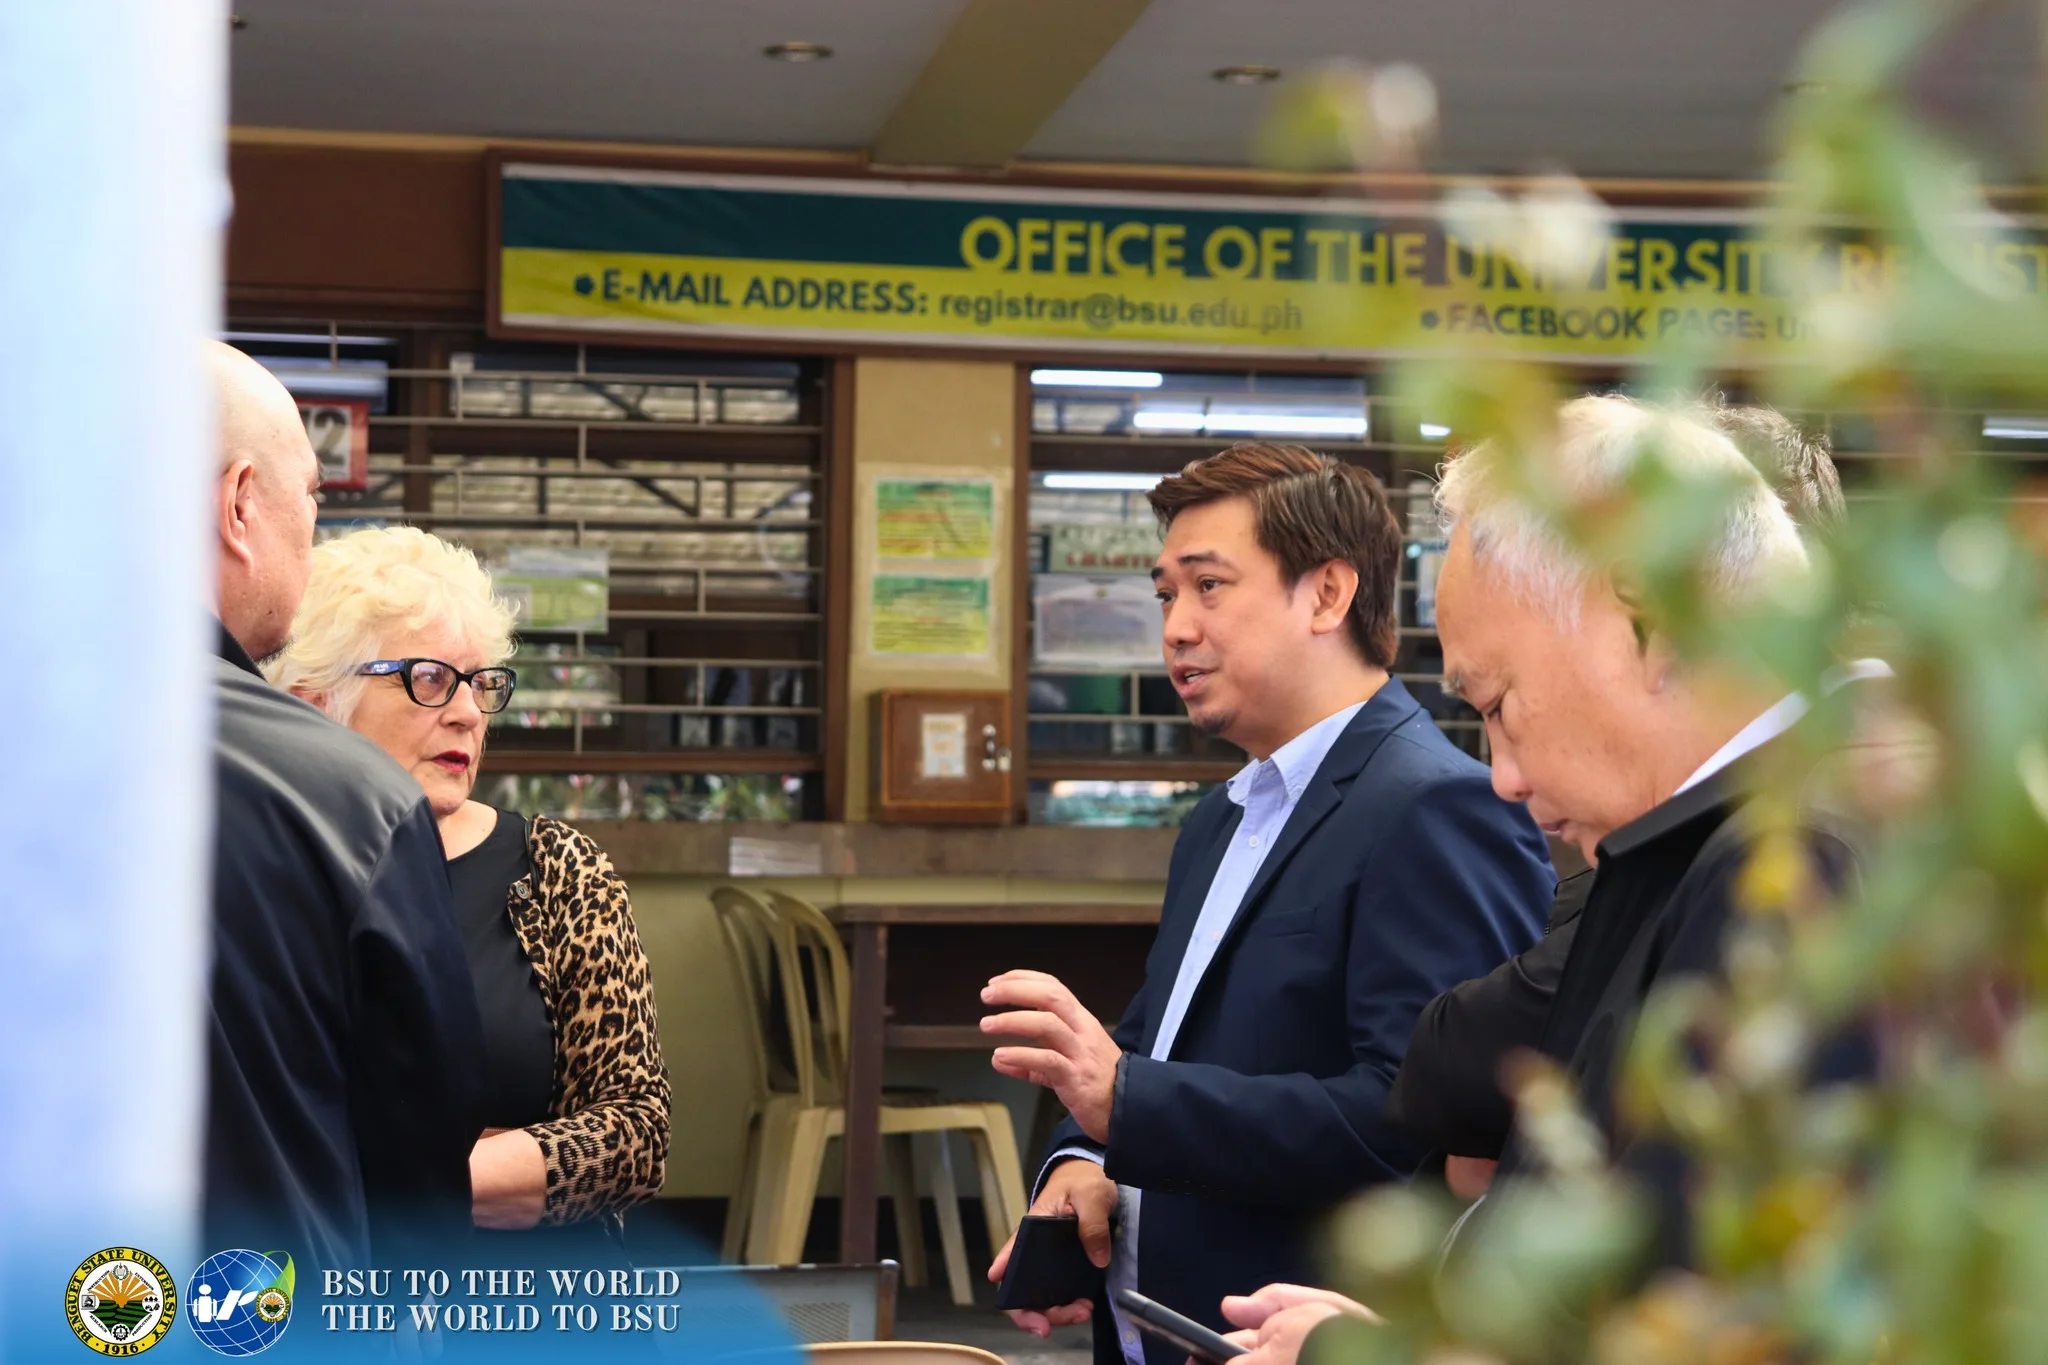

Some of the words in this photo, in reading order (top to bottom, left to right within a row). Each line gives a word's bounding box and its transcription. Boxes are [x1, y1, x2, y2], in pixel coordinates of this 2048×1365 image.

[960, 217, 1187, 278] OFFICE
[1204, 226, 1294, 281] OF
[1305, 230, 1426, 286] THE
[1446, 234, 1822, 297] UNERSIT
[601, 268, 730, 307] E-MAIL
[742, 276, 929, 315] ADDRESS:
[939, 289, 1303, 334] registrar@bsu.edu.ph
[1446, 303, 1647, 340] FACEBOOK
[1658, 306, 1767, 341] PAGE:
